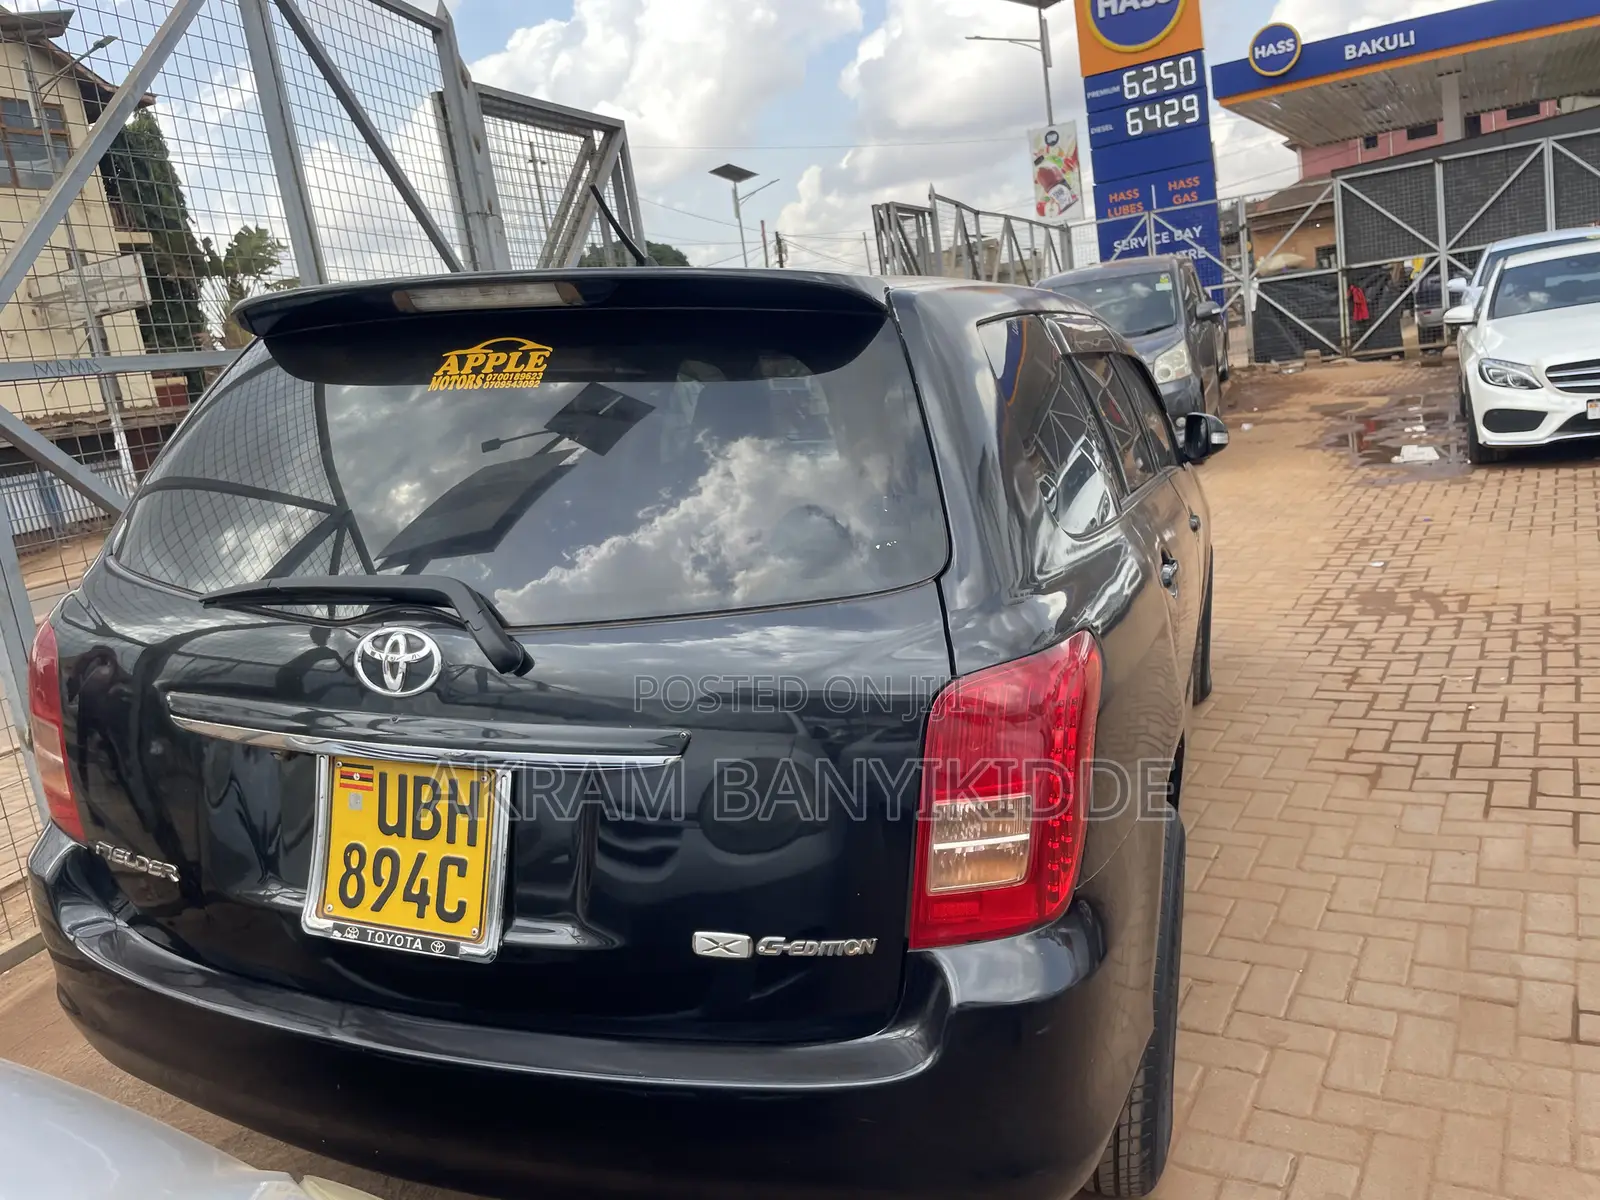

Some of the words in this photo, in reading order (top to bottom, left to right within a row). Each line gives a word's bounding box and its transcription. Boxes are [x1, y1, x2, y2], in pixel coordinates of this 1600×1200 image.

[1097, 0, 1170, 19] HA
[1254, 38, 1296, 60] HASS
[1344, 30, 1415, 61] BAKULI
[1086, 85, 1121, 99] PREMIUM
[1122, 56, 1197, 100] 6250
[1090, 123, 1115, 135] DIESEL
[1125, 94, 1200, 136] 6429
[1168, 176, 1200, 192] HASS
[1108, 188, 1140, 204] HASS
[1172, 192, 1198, 206] GAS
[1107, 202, 1144, 219] LUBES
[1113, 231, 1170, 253] SERVCE
[1173, 225, 1203, 242] BAY
[434, 350, 551, 376] APPLE
[427, 373, 484, 392] MOTORS
[377, 771, 481, 847] UBH
[338, 842, 468, 923] 894C
[366, 929, 423, 951] TOYOTA
[756, 936, 878, 956] G-EDITION
